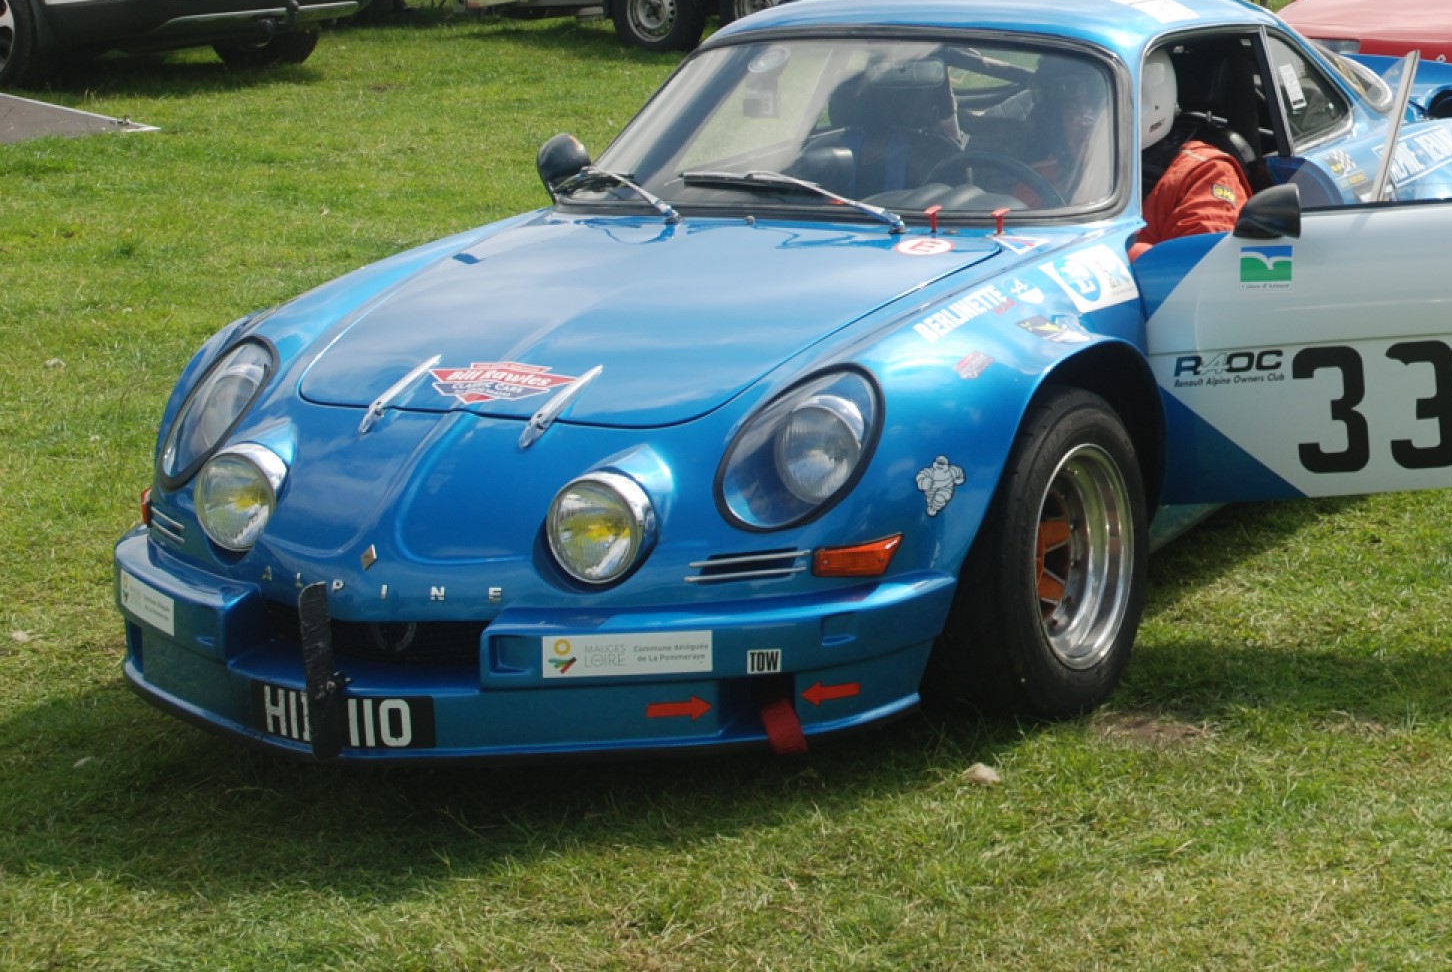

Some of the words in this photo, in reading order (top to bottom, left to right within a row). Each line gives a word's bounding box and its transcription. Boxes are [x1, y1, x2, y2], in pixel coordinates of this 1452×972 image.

[913, 284, 1009, 344] BERLINETTE
[447, 370, 478, 382] Bill
[481, 369, 552, 386] Rawles
[1174, 377, 1204, 388] Renault
[1206, 375, 1231, 386] Alpine
[1234, 374, 1265, 384] Owners
[1267, 372, 1285, 382] Club
[262, 565, 503, 602] ALPINE
[584, 644, 627, 654] MAUGES
[633, 644, 673, 653] Commune
[584, 654, 627, 668] LOIRE
[637, 654, 647, 662] de
[649, 653, 658, 661] La
[749, 650, 780, 672] TOW
